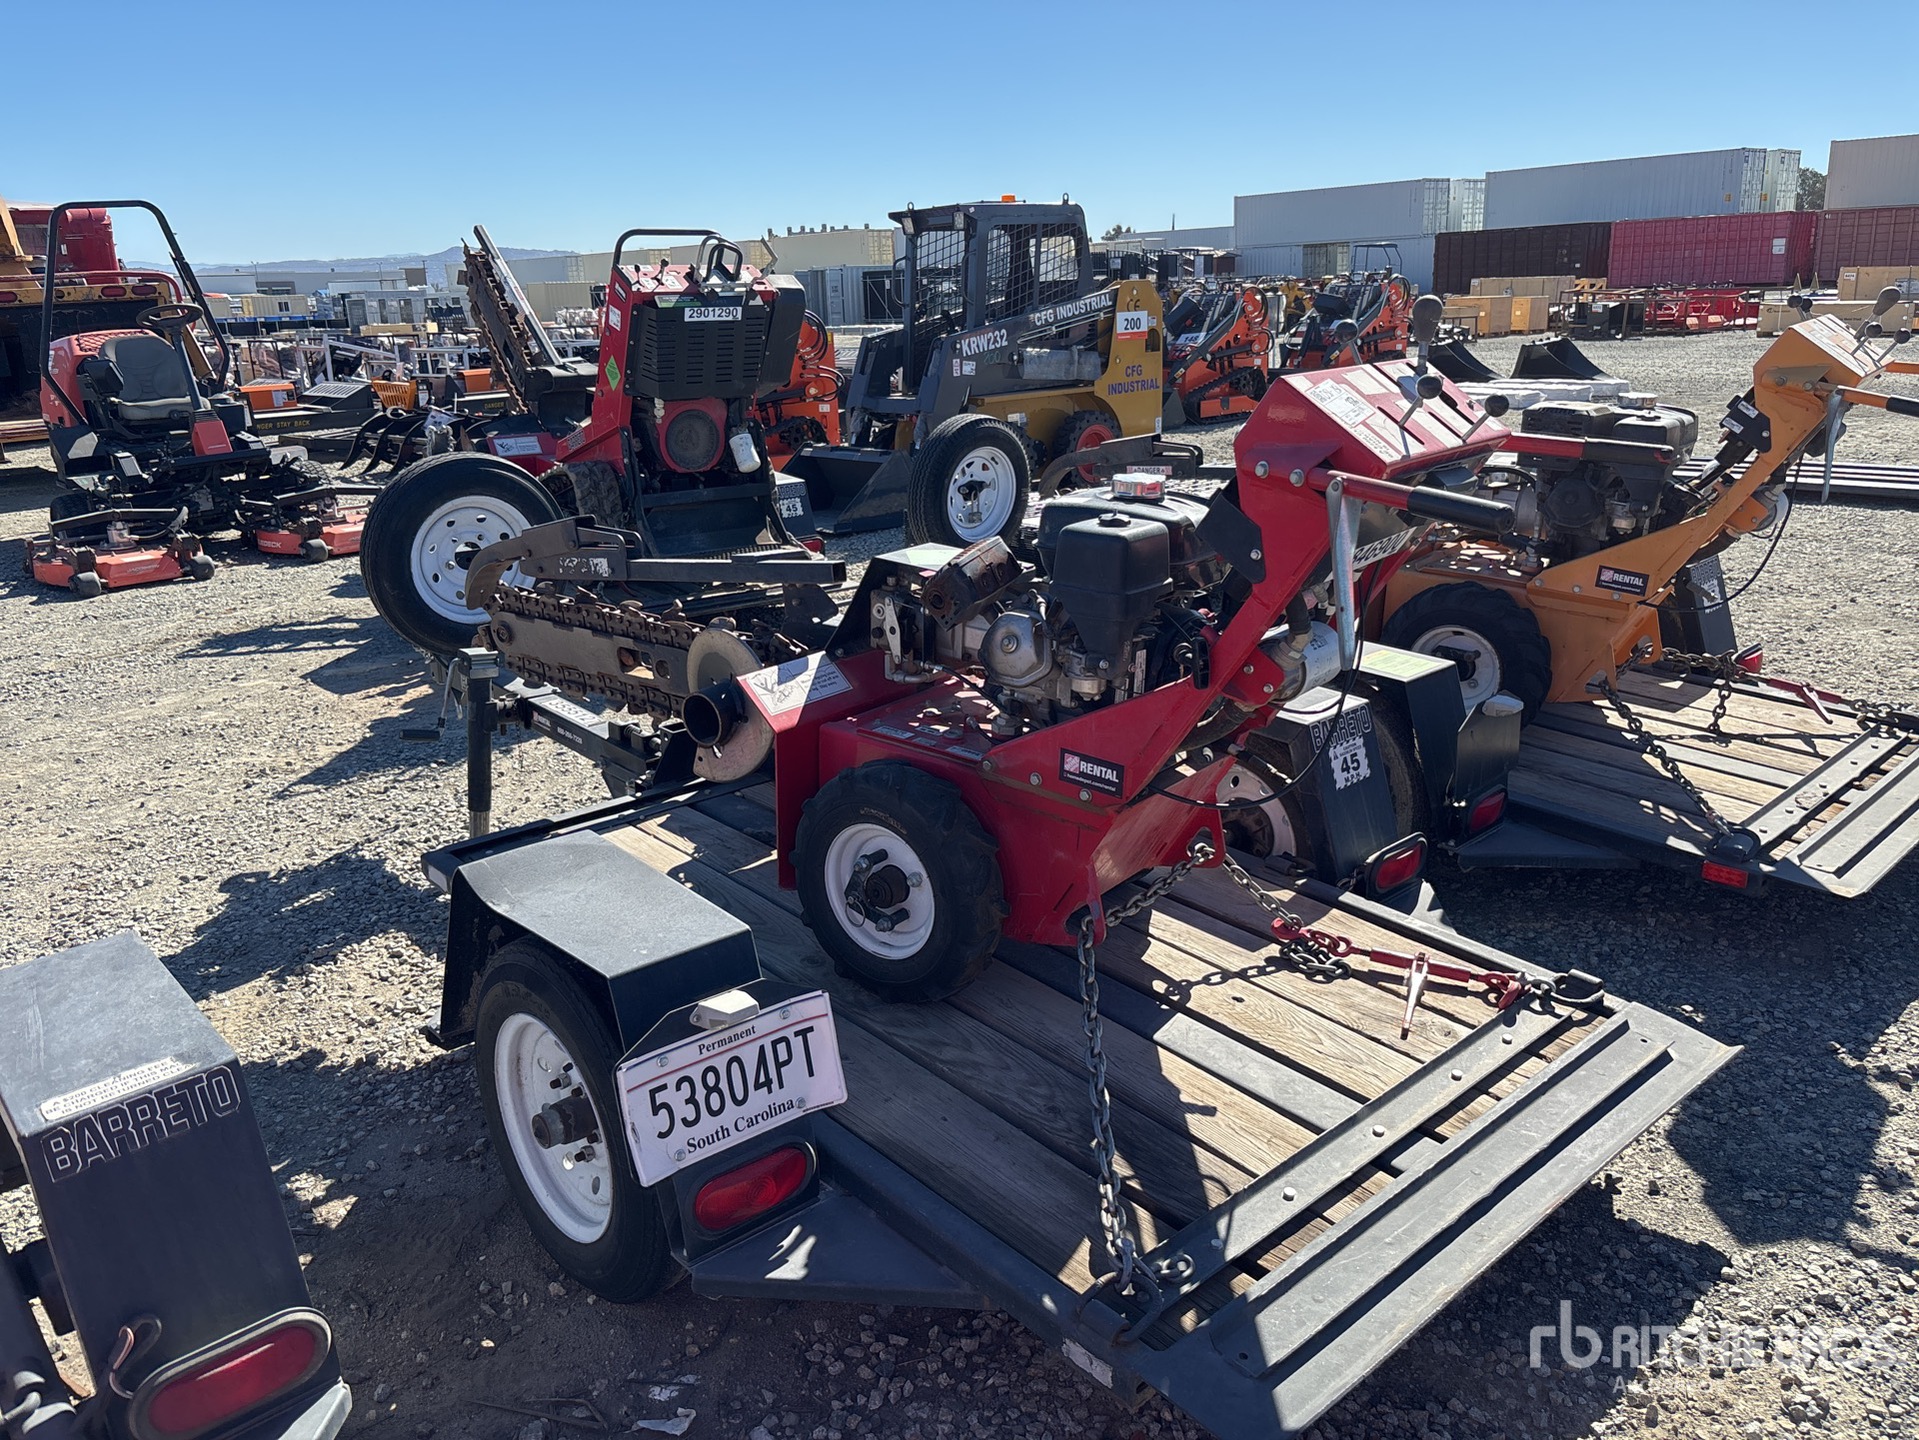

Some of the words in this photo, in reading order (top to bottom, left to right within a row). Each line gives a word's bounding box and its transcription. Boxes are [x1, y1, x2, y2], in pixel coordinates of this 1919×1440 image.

[688, 307, 739, 319] 2901290
[1034, 310, 1055, 326] CFG
[1056, 294, 1112, 320] INDUSTRIAL
[1123, 317, 1142, 331] 200
[961, 328, 1008, 357] KRW232
[1125, 364, 1143, 378] CFG
[1107, 378, 1160, 396] INDUSTRIAL
[276, 421, 292, 429] STAY
[294, 419, 311, 427] BACK
[1137, 465, 1161, 474] DANGER
[786, 504, 798, 512] 45
[1613, 573, 1644, 587] RENTAL
[1080, 760, 1119, 783] RENTAL
[1340, 752, 1361, 774] 45
[698, 1024, 757, 1055] Permanent
[146, 1063, 167, 1074] FEE
[63, 1085, 118, 1108] CHARGED
[134, 1070, 158, 1083] THIS
[75, 1098, 97, 1109] NOT
[101, 1075, 160, 1101] RETURNED
[648, 1025, 816, 1140] 53804PT
[40, 1065, 241, 1183] BARRETO
[686, 1124, 731, 1154] South
[734, 1098, 795, 1133] Carolina
